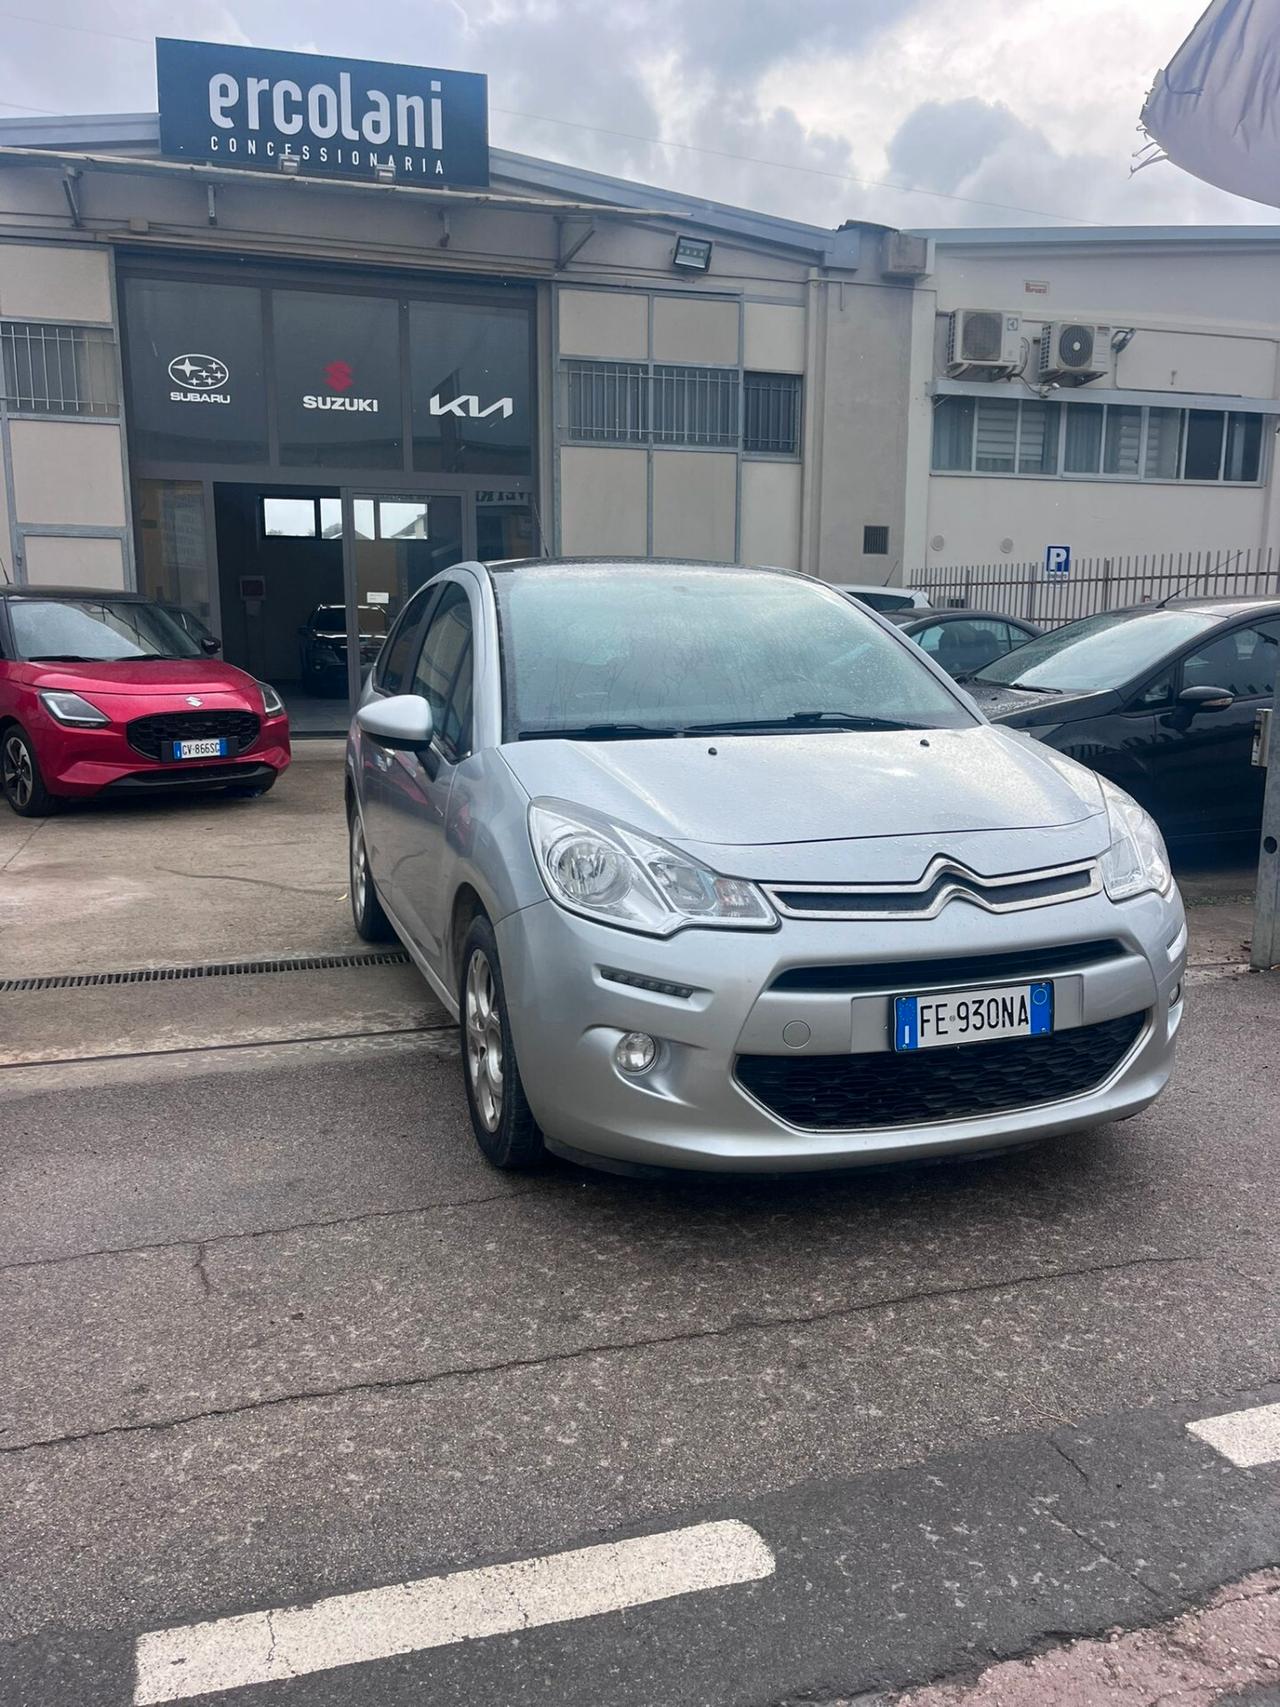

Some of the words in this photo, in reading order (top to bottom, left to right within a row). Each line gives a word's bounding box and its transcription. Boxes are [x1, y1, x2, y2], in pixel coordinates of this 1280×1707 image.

[209, 72, 443, 150] ercolani
[210, 136, 444, 174] CONCESSIONARIA
[170, 391, 231, 404] SUBARU
[303, 395, 379, 412] SUZUKI
[429, 393, 513, 419] KIA
[1049, 548, 1067, 570] P
